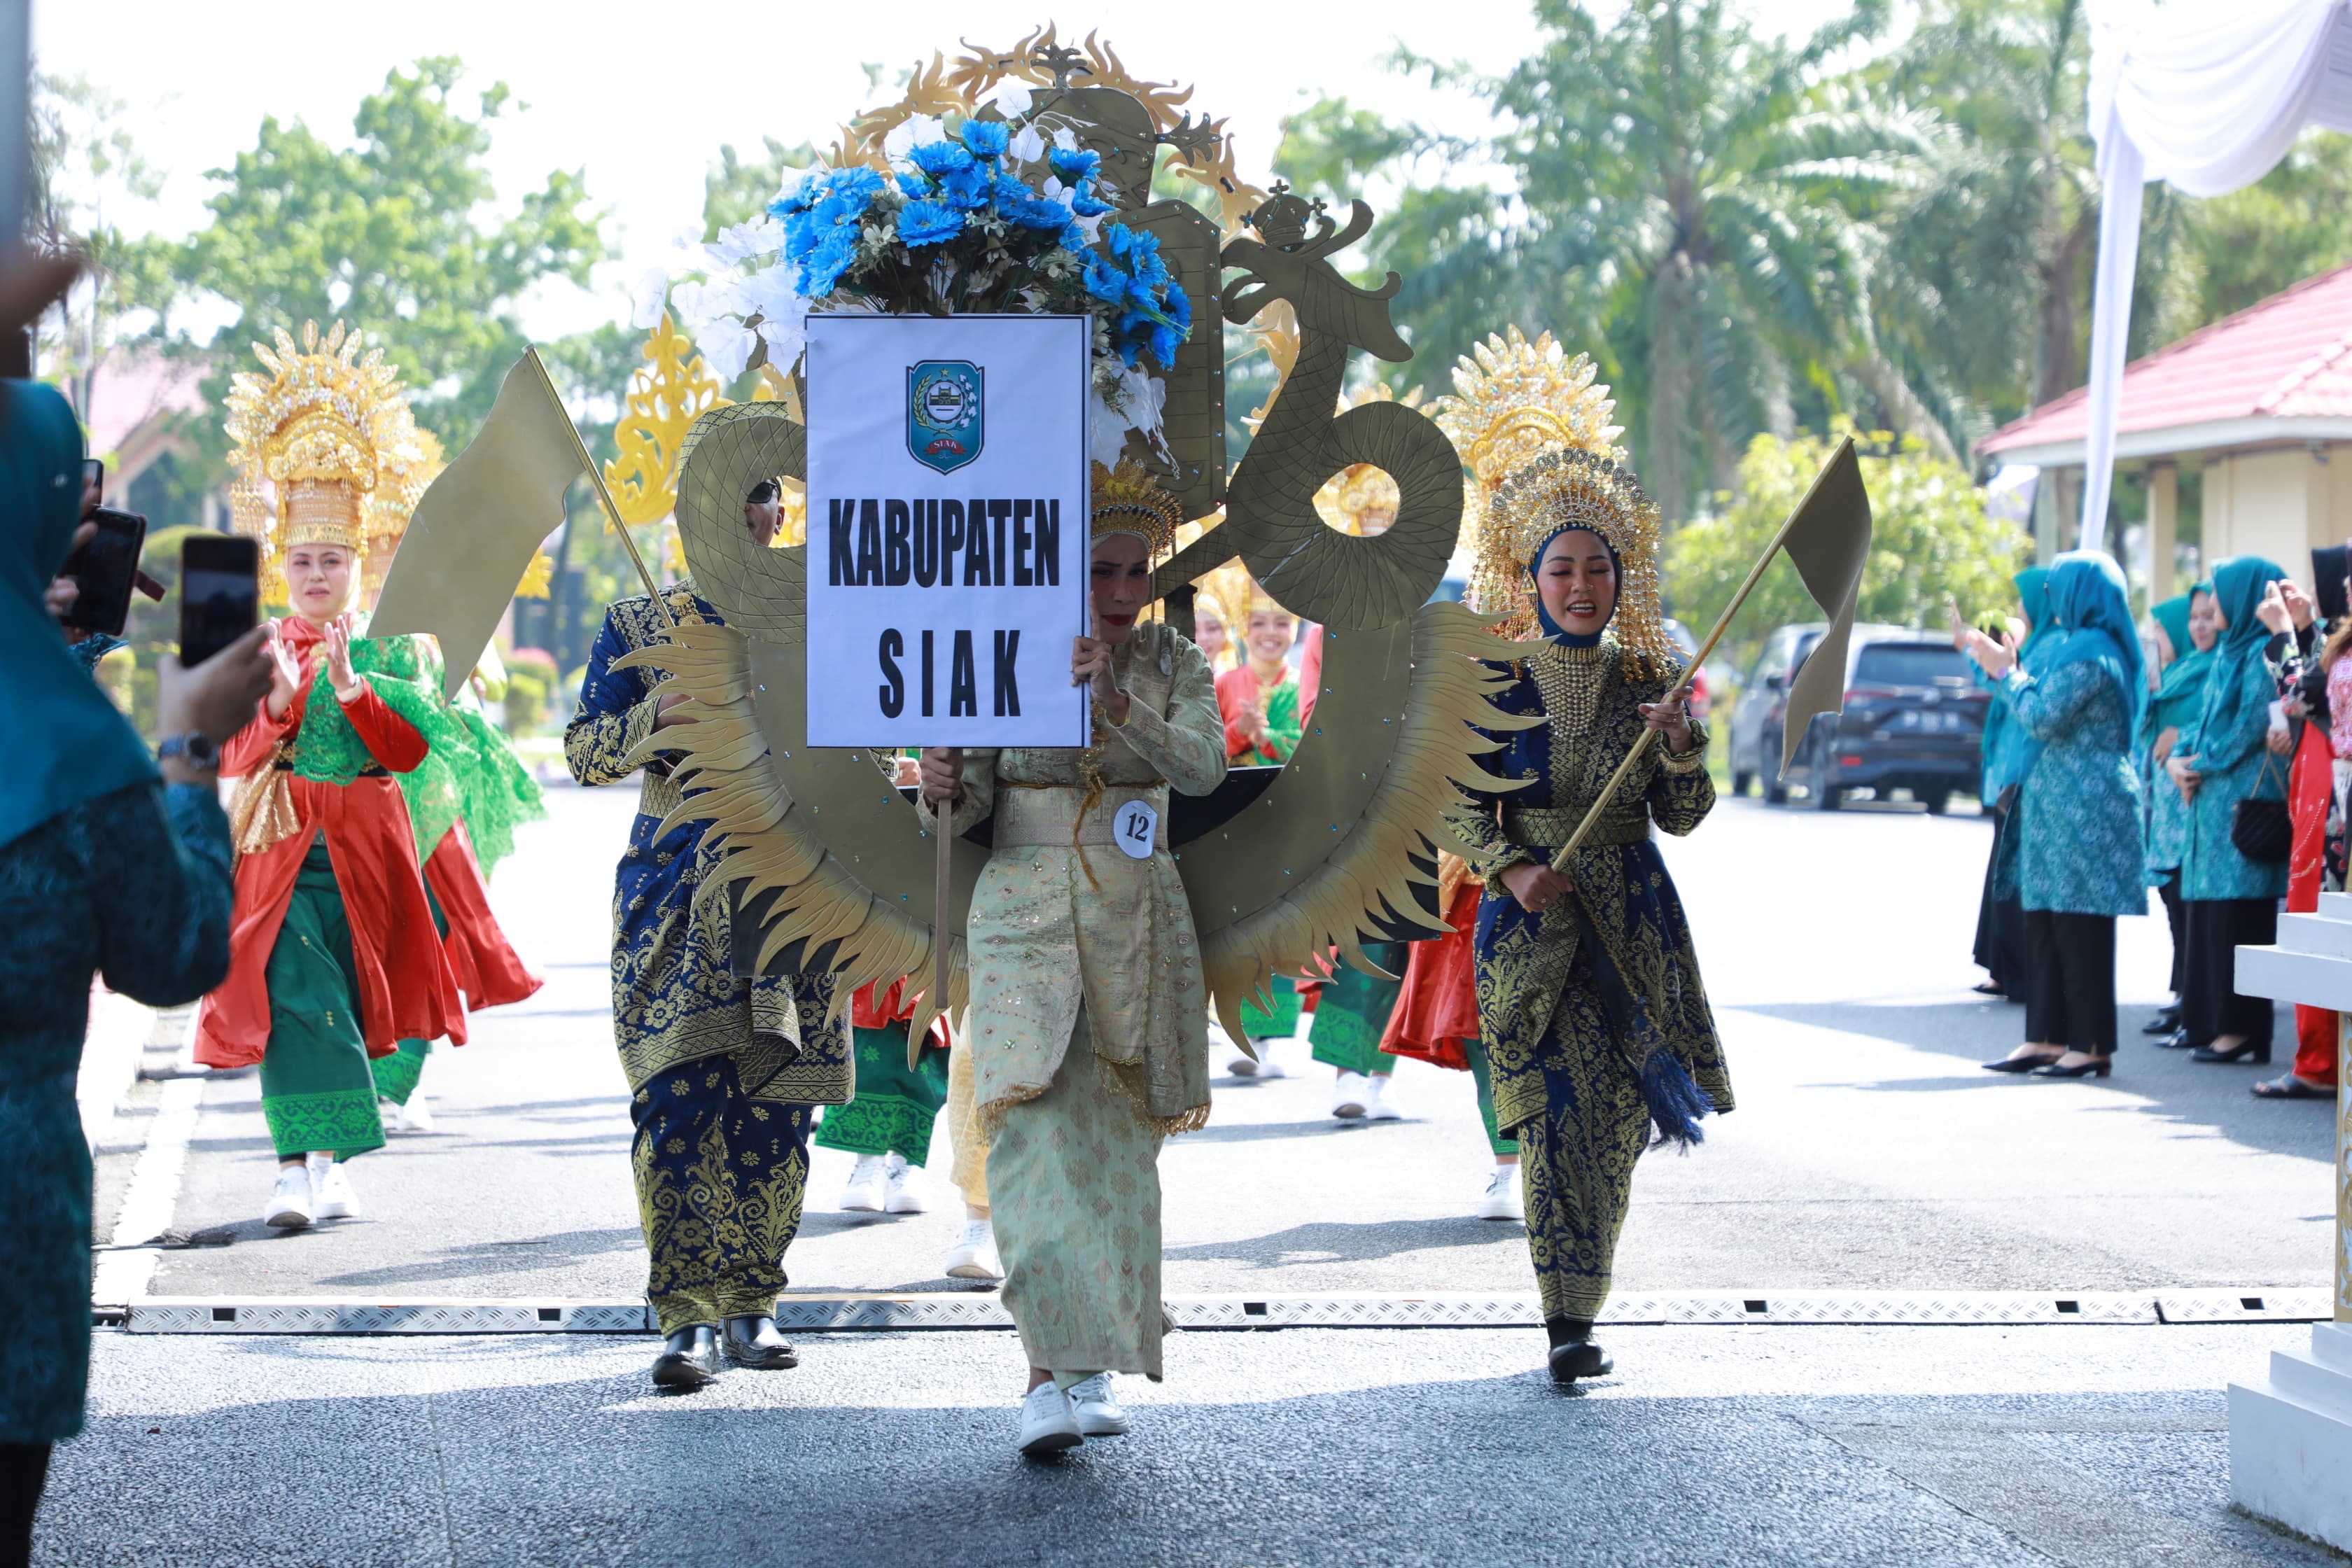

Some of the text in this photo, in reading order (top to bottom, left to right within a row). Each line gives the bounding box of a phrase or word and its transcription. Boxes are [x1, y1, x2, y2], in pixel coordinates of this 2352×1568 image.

[934, 440, 957, 449] SIAK
[829, 498, 1060, 588] KABUPATEN
[878, 628, 1021, 719] SIAK
[1126, 812, 1149, 843] 12
